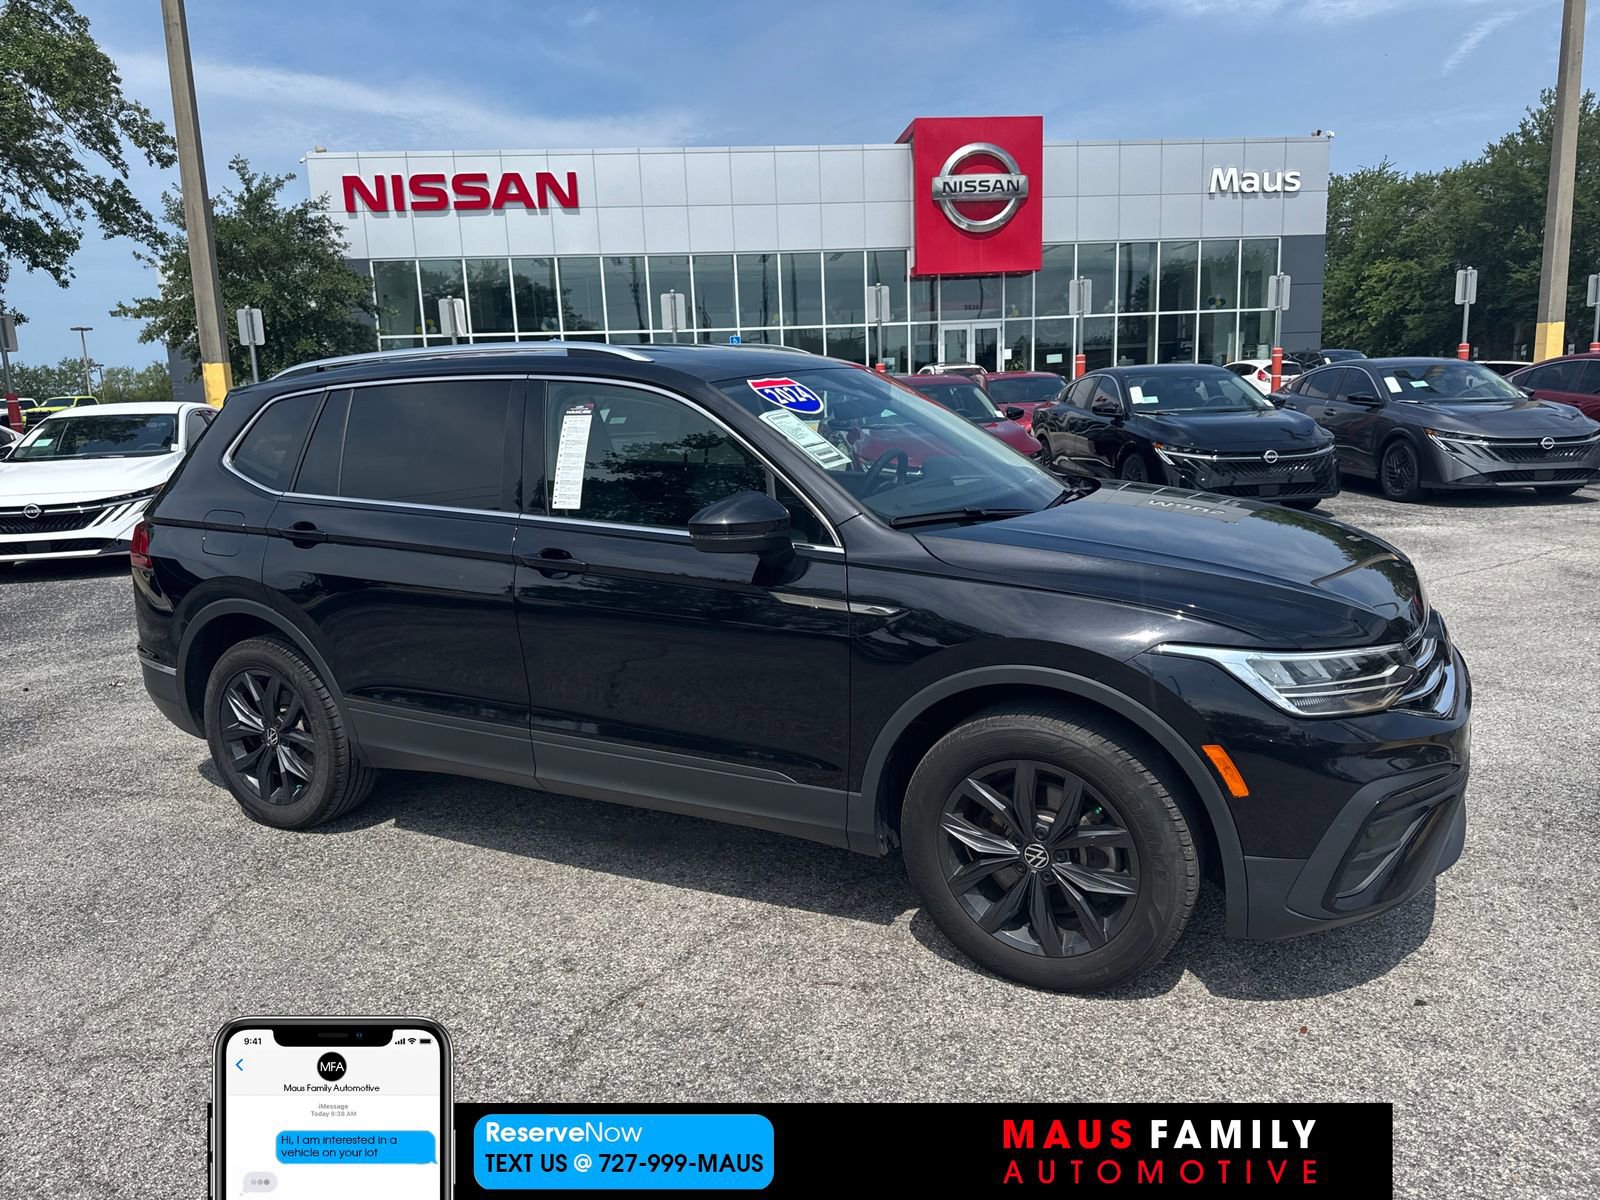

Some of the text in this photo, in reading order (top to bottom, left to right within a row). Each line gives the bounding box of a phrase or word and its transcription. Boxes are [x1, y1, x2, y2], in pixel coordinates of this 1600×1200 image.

[941, 179, 1021, 196] NISSAN
[1209, 166, 1302, 194] Maus
[342, 171, 579, 213] NISSAN
[764, 385, 816, 404] 2024
